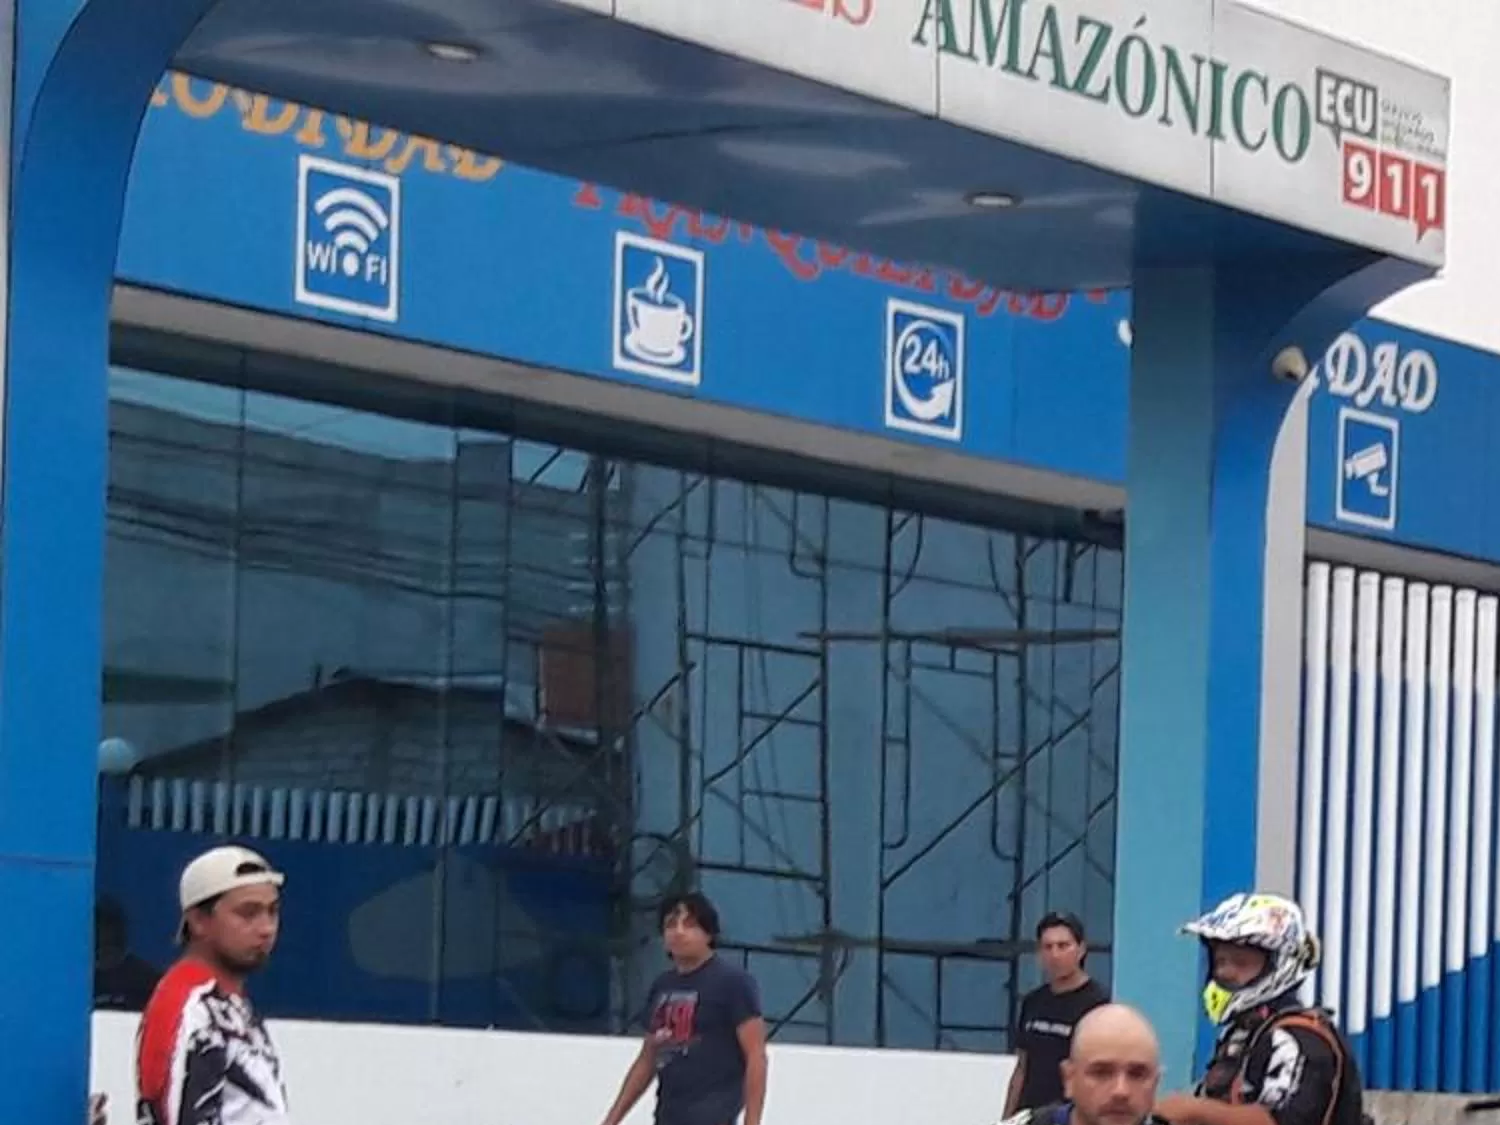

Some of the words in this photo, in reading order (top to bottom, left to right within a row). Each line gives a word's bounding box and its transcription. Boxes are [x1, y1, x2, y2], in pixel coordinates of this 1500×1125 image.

[912, 0, 1310, 163] AMAZÓNICO
[1319, 76, 1374, 134] ECU
[1347, 151, 1438, 224] 911
[904, 333, 950, 380] 24h
